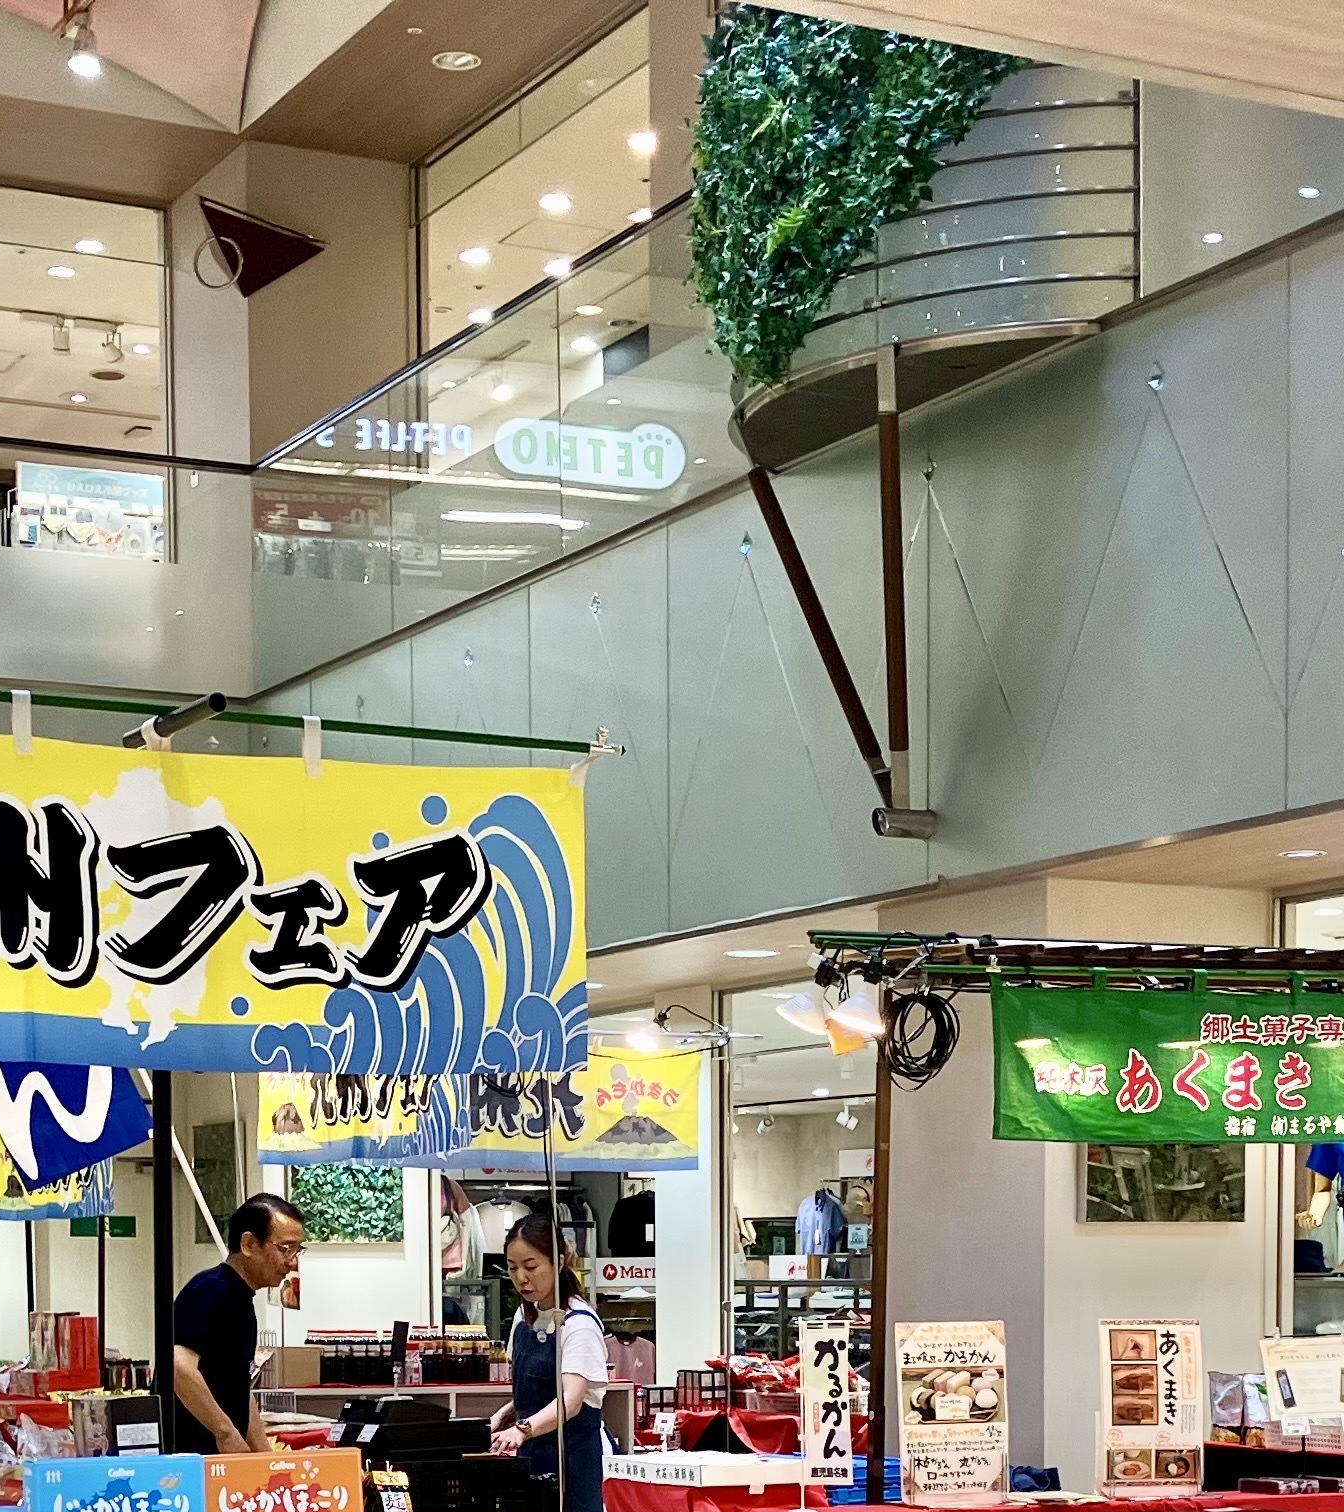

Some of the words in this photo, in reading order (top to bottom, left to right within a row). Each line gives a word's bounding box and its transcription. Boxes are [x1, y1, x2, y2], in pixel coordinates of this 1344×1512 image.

[1117, 1047, 1312, 1114] あくまき
[1223, 1115, 1258, 1137] 指宿
[620, 1264, 656, 1280] Mar
[812, 1338, 847, 1460] かるかん
[1158, 1329, 1181, 1427] あくまき
